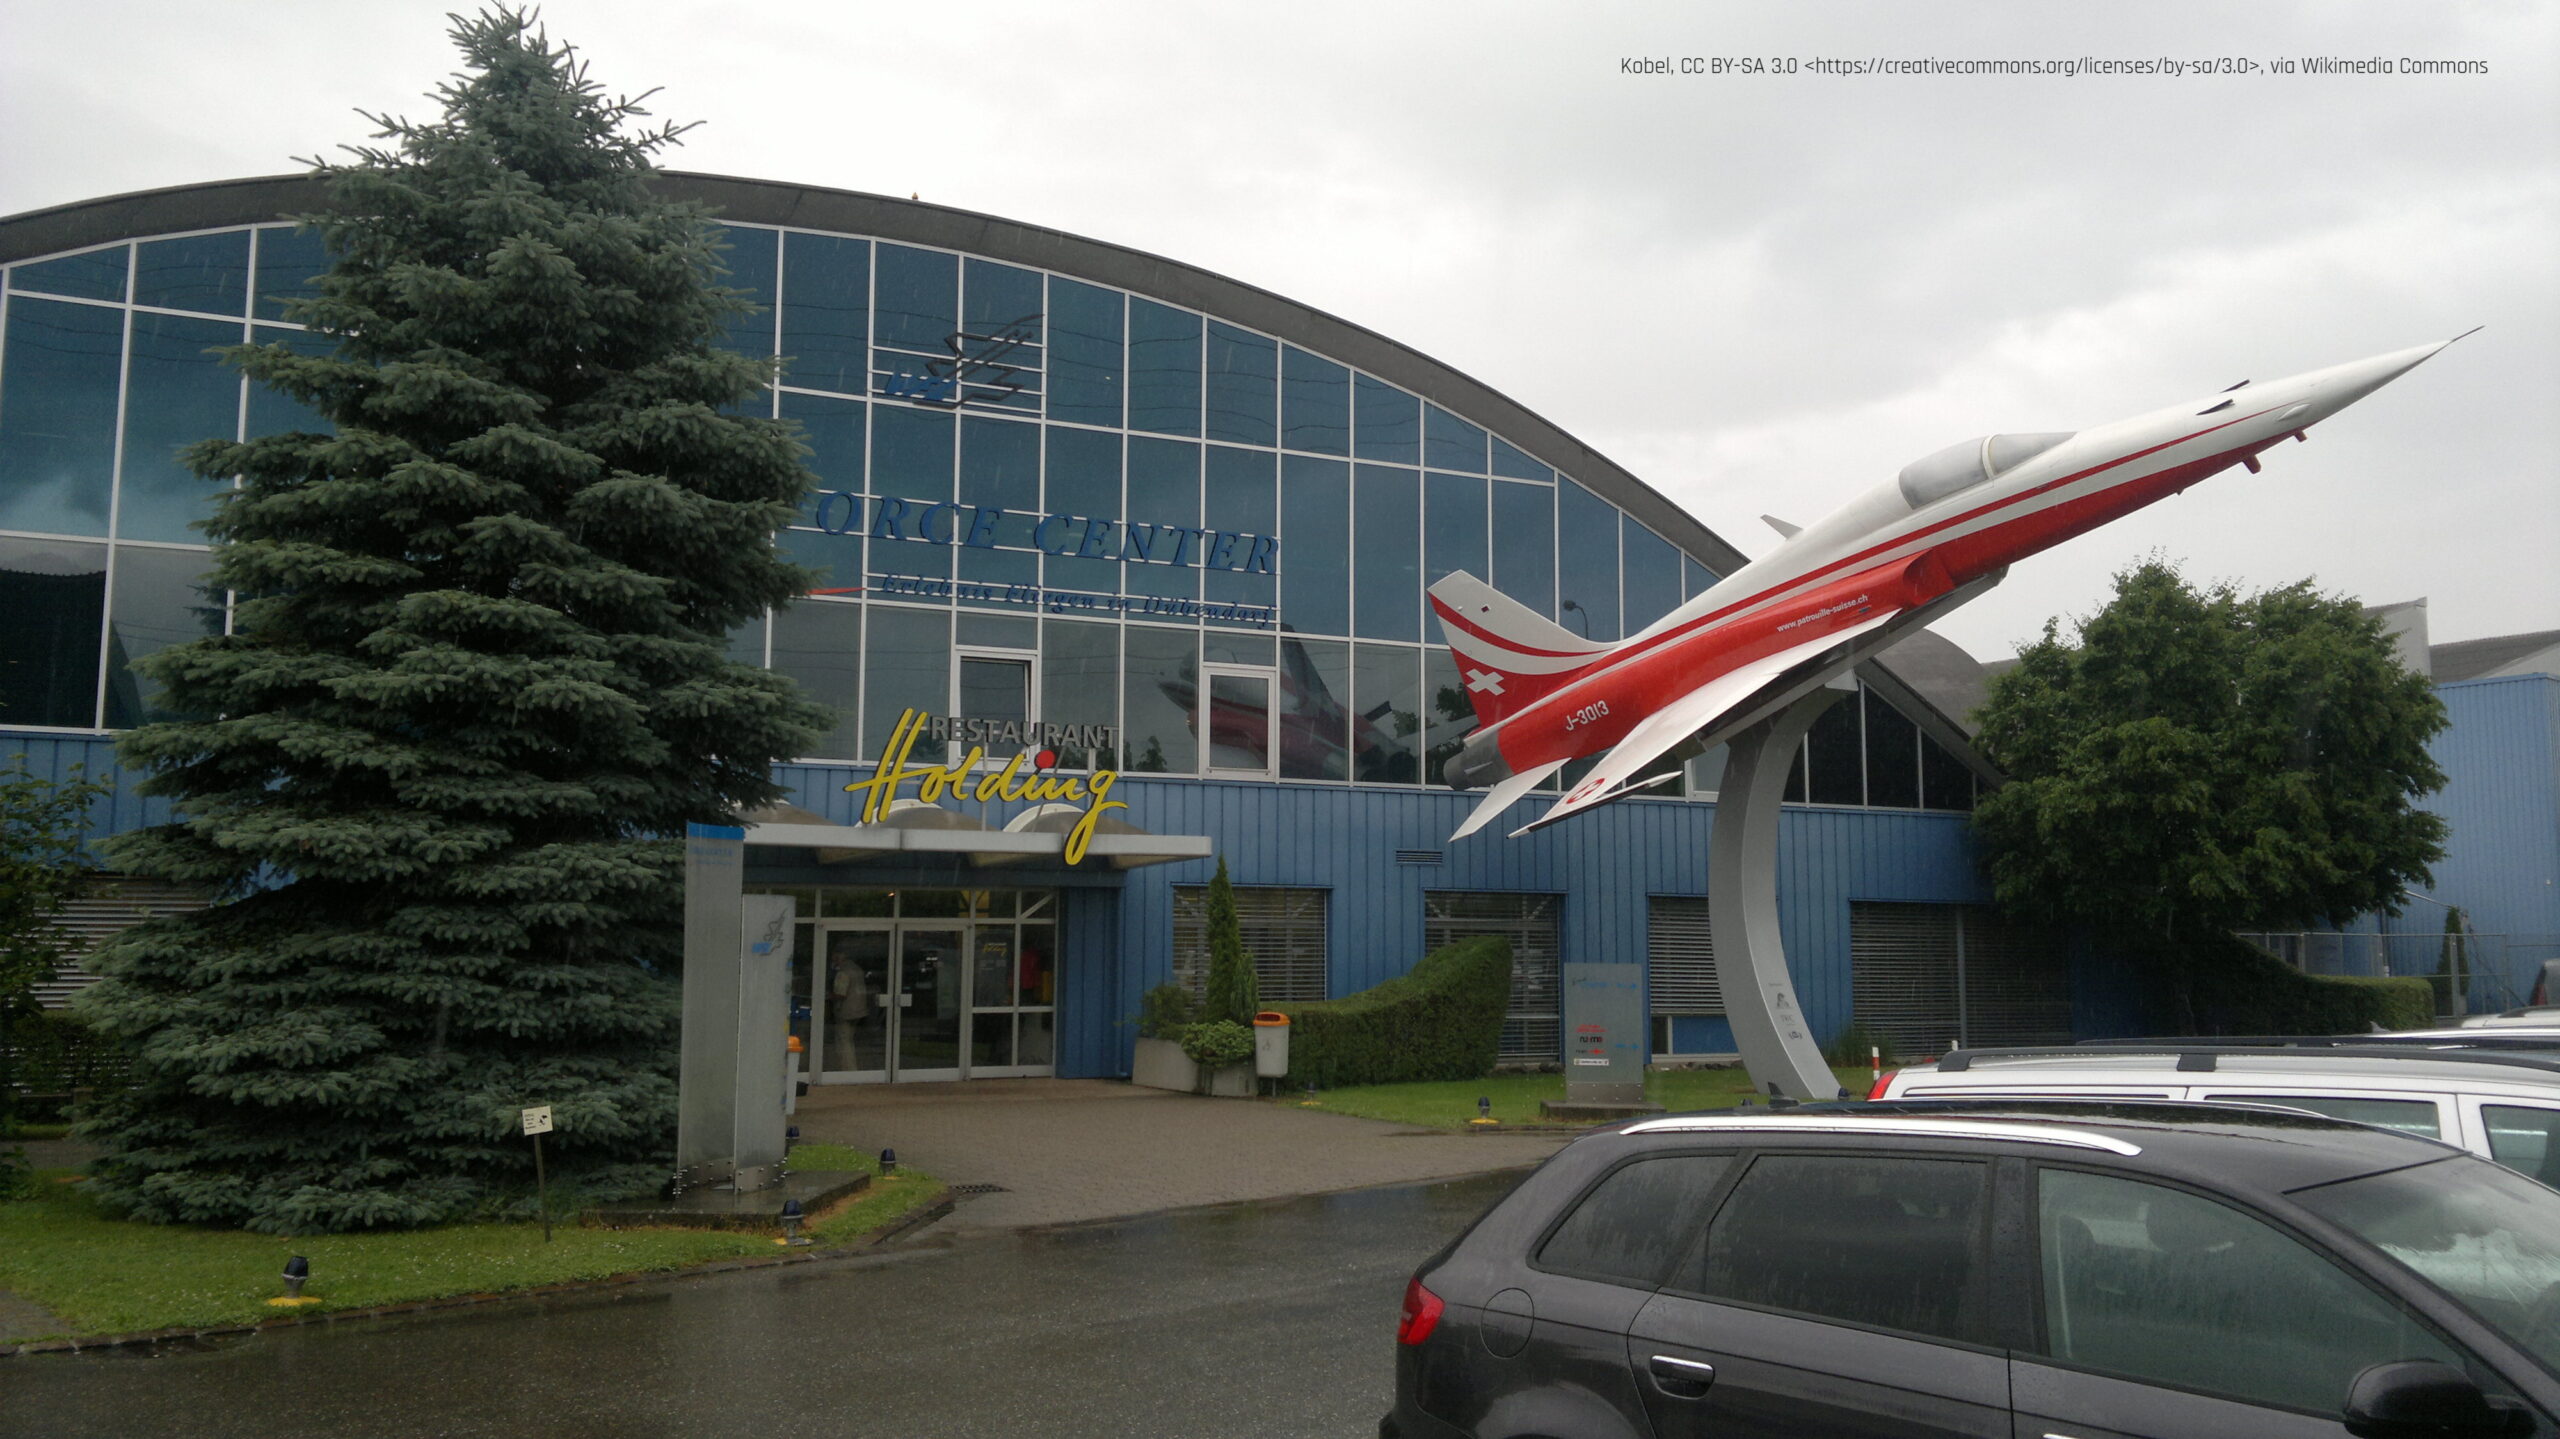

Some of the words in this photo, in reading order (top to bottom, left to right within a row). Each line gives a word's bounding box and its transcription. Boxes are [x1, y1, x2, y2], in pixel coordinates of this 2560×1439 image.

[797, 489, 1003, 548] ORCE
[1033, 513, 1280, 575] CENTER
[1107, 591, 1132, 611] in
[1776, 594, 1869, 632] www.patrouille-suisse.ch
[930, 716, 1120, 749] RESTAURANT
[1566, 700, 1610, 731] J-3013
[843, 708, 1129, 866] Holding
